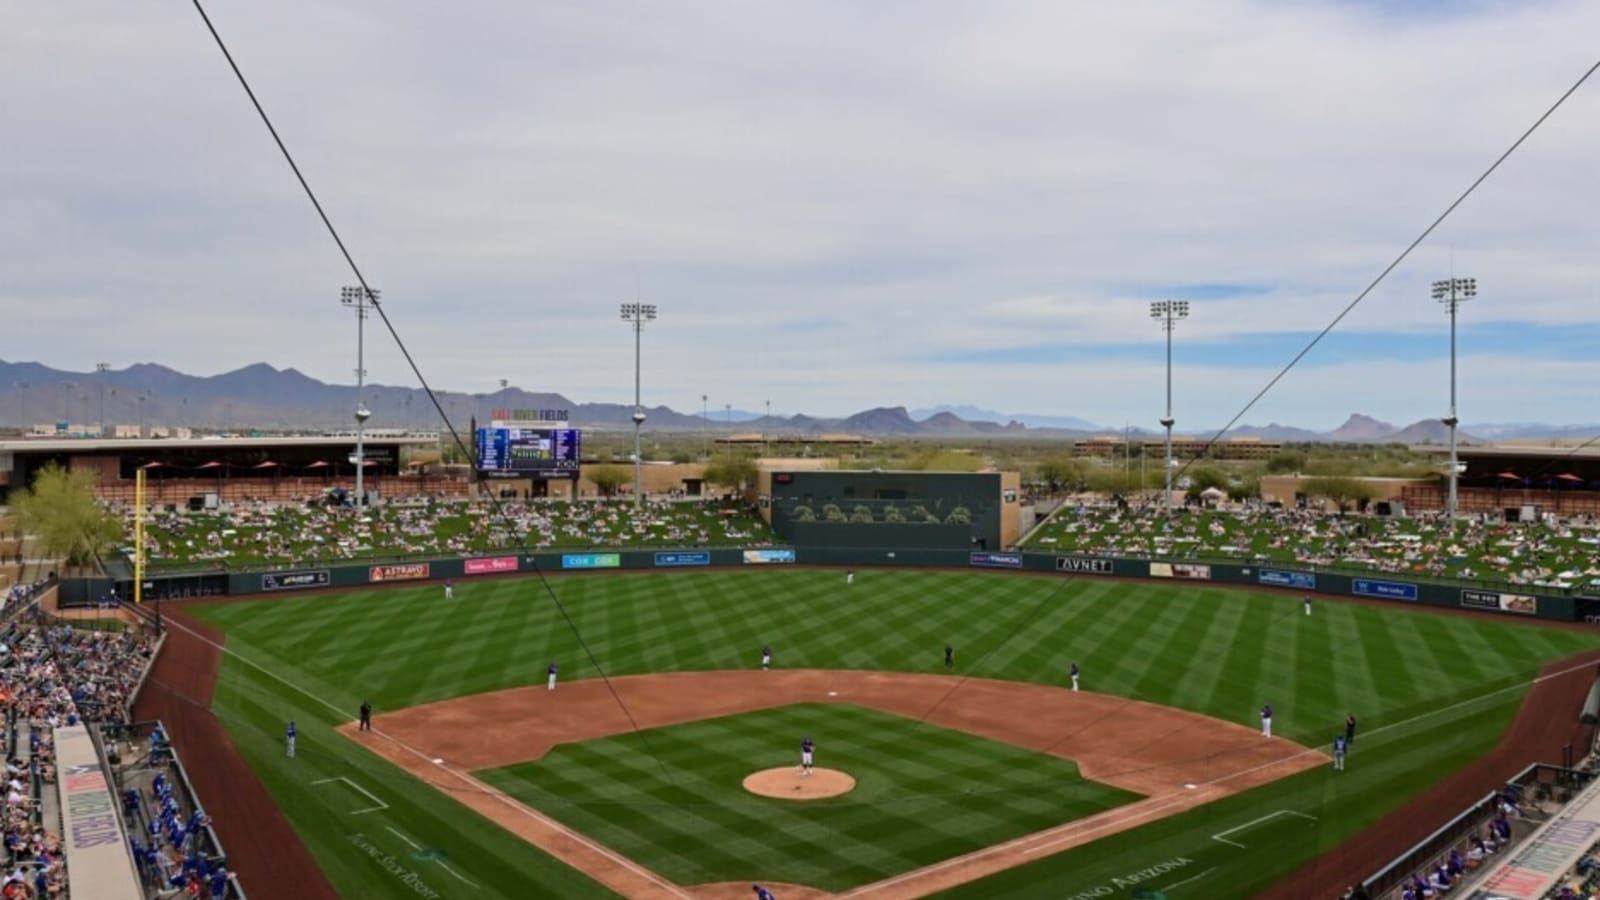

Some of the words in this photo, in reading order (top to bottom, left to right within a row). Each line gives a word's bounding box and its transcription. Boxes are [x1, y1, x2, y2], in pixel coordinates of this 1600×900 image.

[540, 409, 568, 421] FIELDS
[1062, 557, 1107, 571] AVNET
[1112, 857, 1194, 888] ARIZONA
